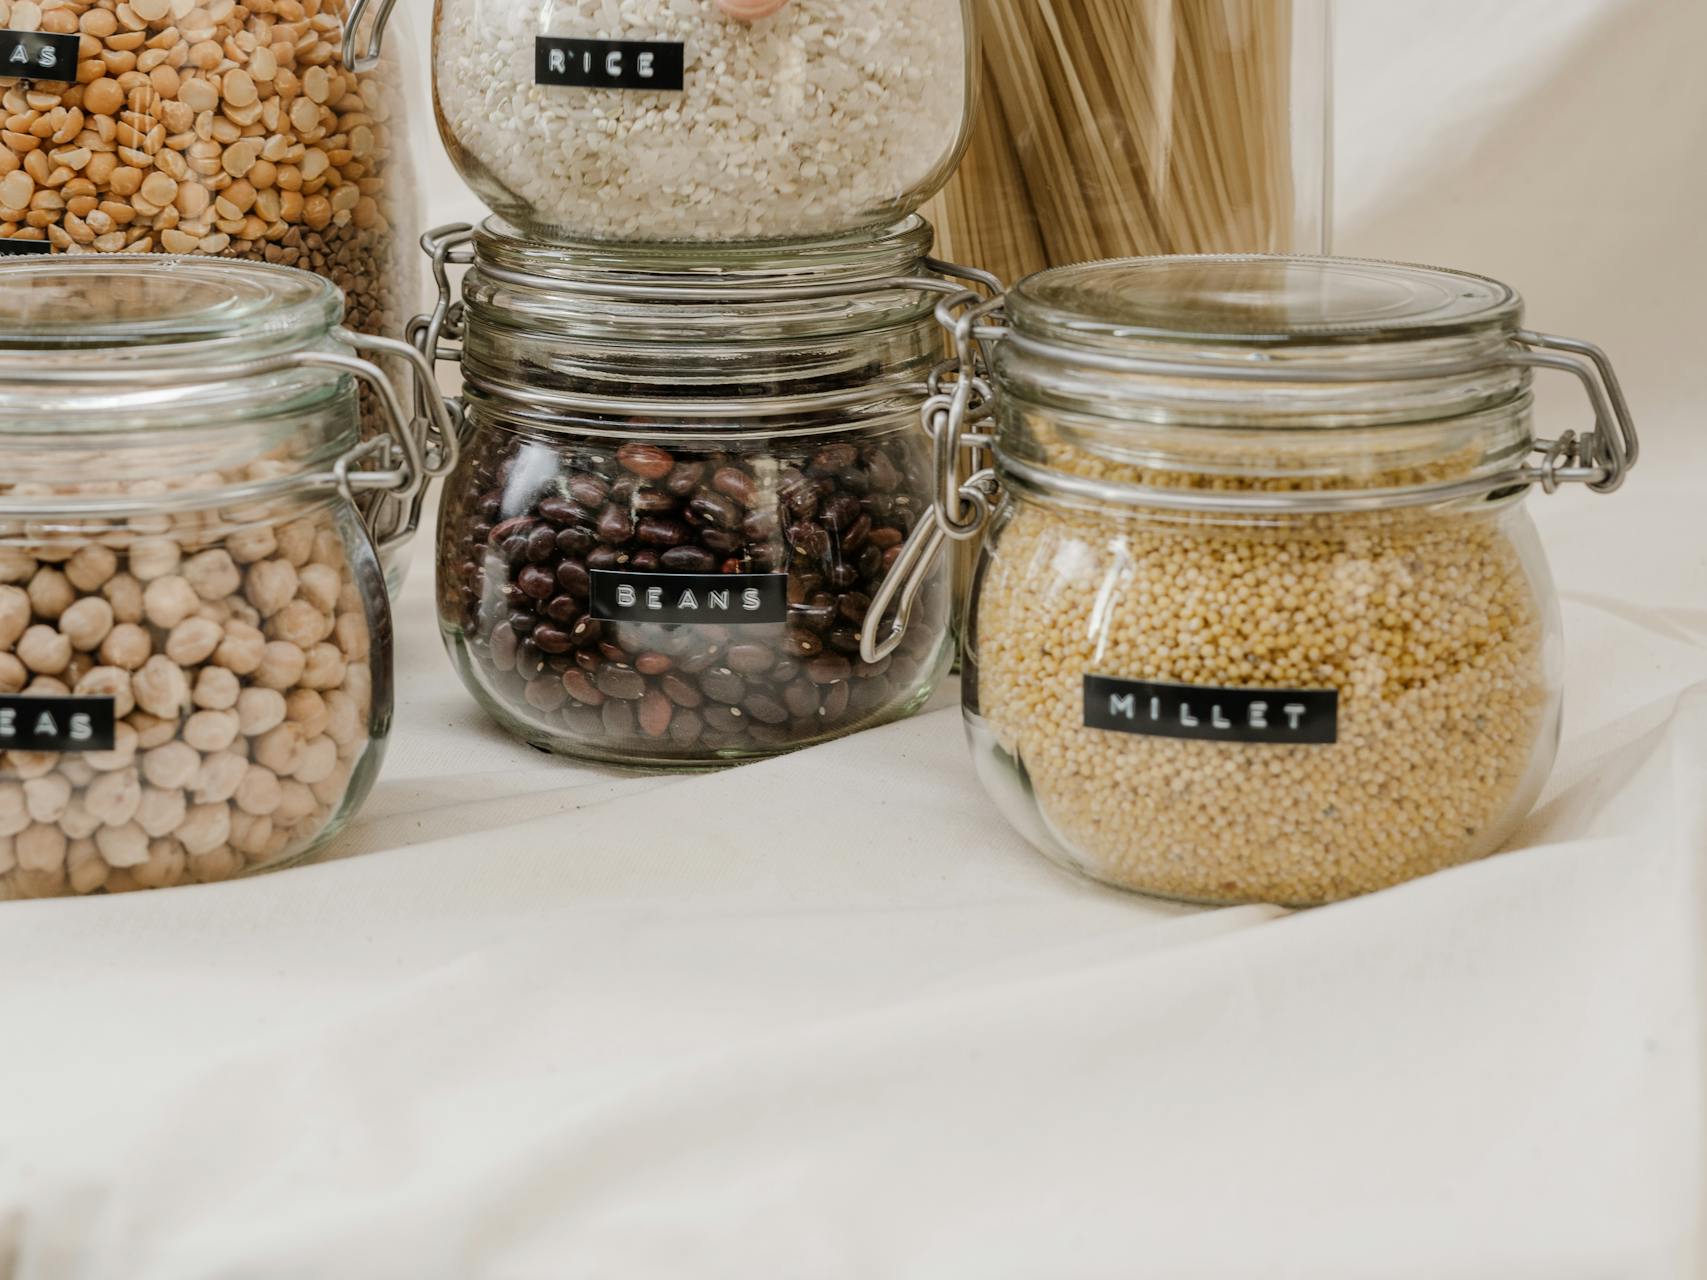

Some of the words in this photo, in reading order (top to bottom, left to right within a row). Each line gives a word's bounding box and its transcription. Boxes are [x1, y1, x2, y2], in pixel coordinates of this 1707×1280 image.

[549, 48, 654, 78] RICE
[616, 584, 761, 610] BEANS
[1110, 693, 1306, 729] MILLET
